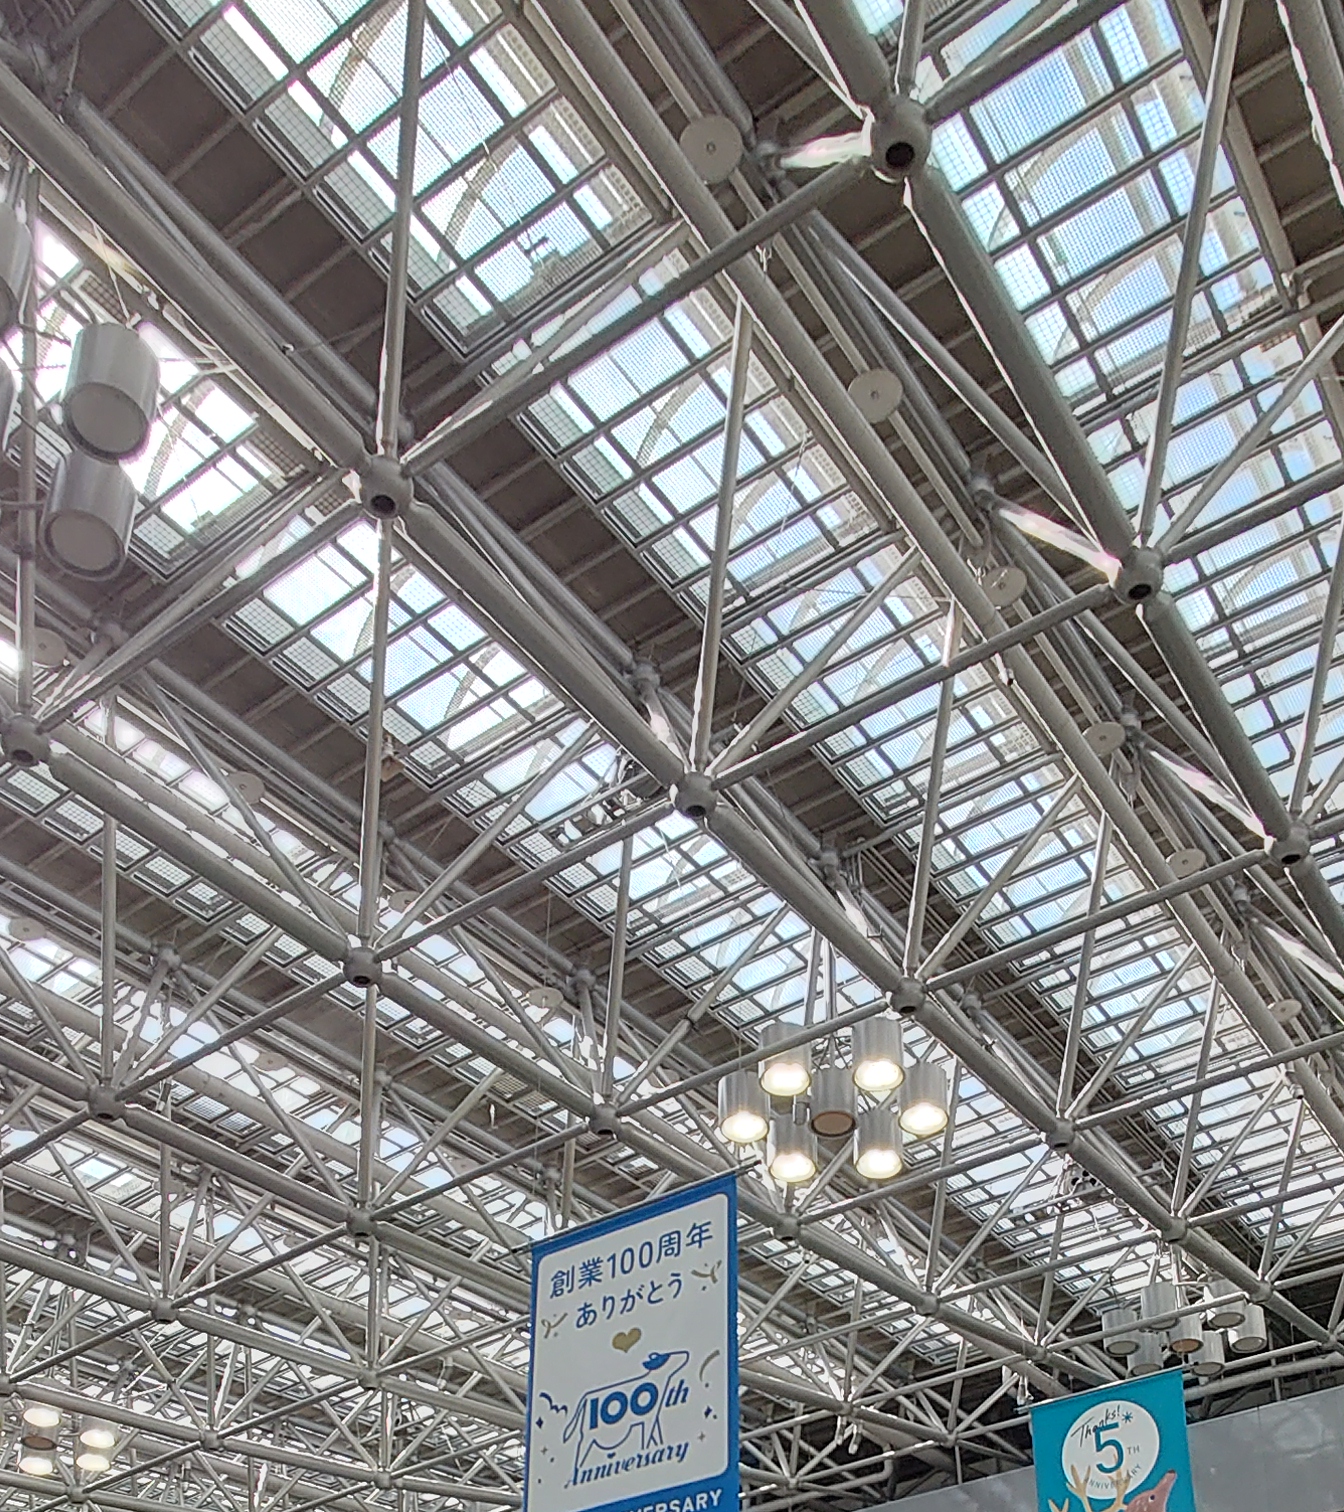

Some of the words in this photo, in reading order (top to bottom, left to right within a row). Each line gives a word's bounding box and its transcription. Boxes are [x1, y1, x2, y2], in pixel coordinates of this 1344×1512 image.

[550, 1221, 713, 1299] 創業100周年
[576, 1273, 683, 1329] ありがとう
[590, 1379, 689, 1430] 100th
[1071, 1405, 1120, 1447] Thanks!
[564, 1442, 689, 1489] Anniversary
[1095, 1422, 1123, 1473] 5
[1127, 1446, 1140, 1454] TH
